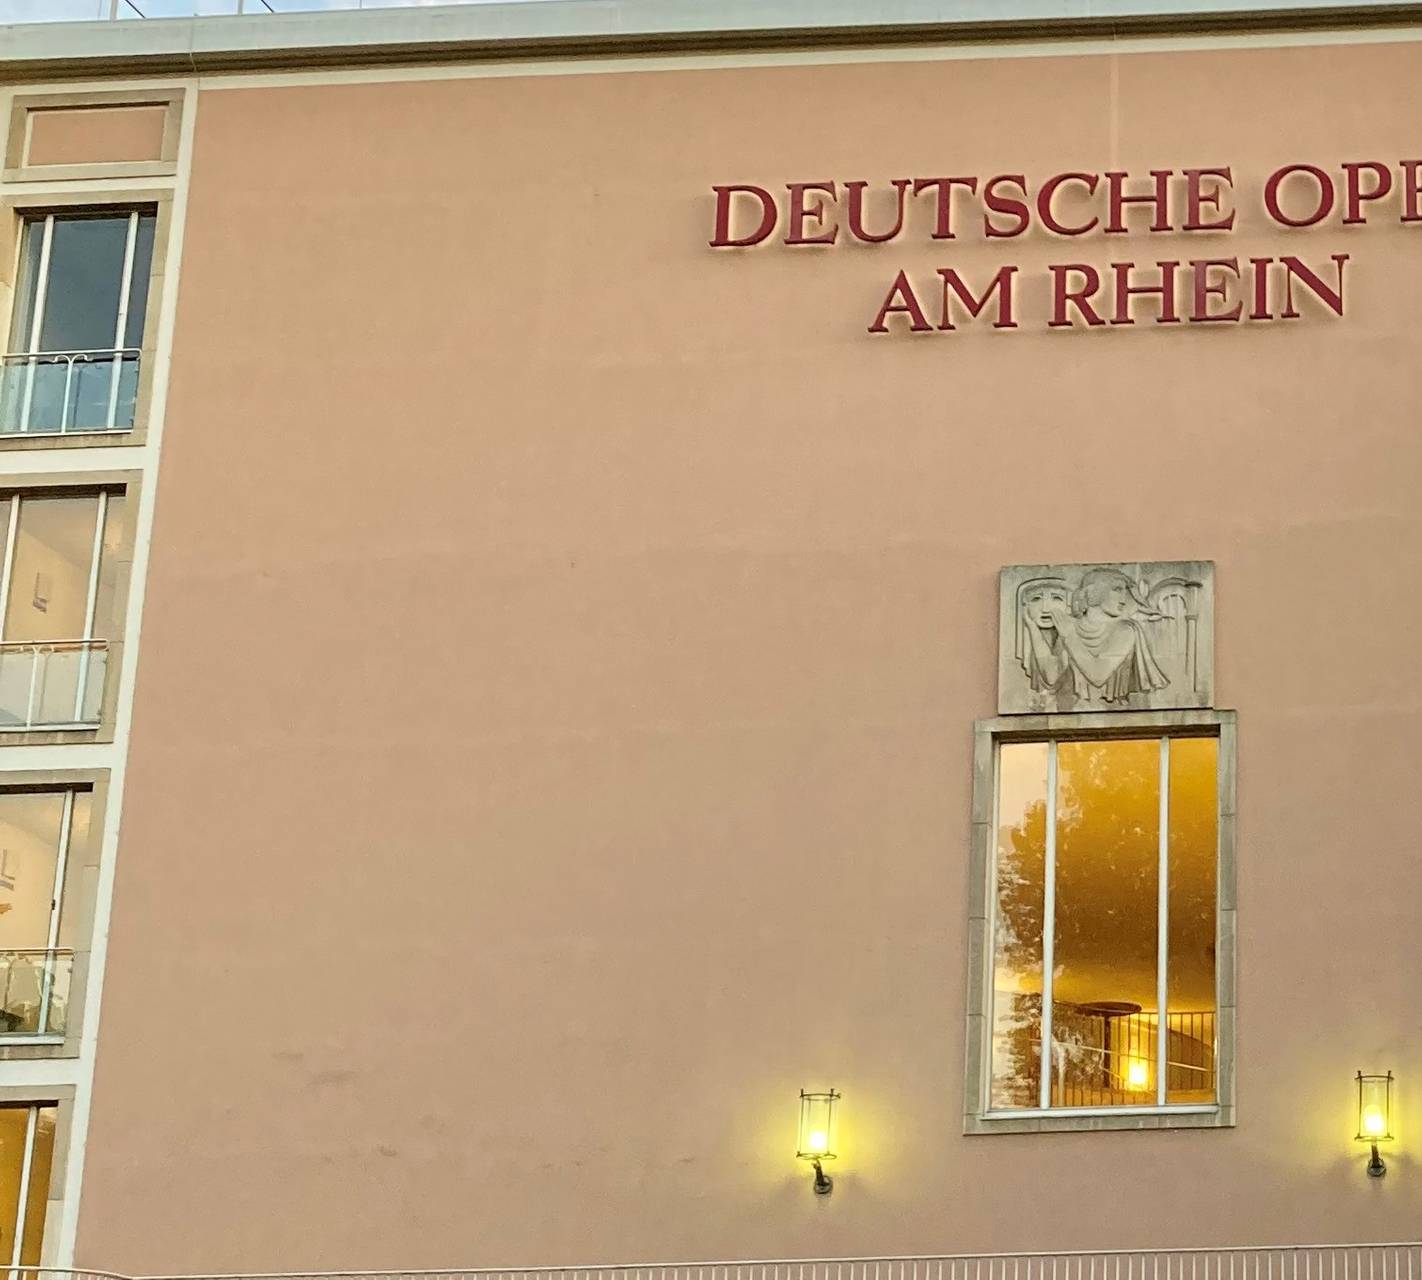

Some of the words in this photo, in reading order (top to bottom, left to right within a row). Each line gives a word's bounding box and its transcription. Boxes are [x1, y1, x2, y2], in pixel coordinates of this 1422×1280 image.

[709, 167, 1236, 248] DEUTSCHE
[868, 265, 1019, 333] AM
[1047, 253, 1350, 327] RHEIN
